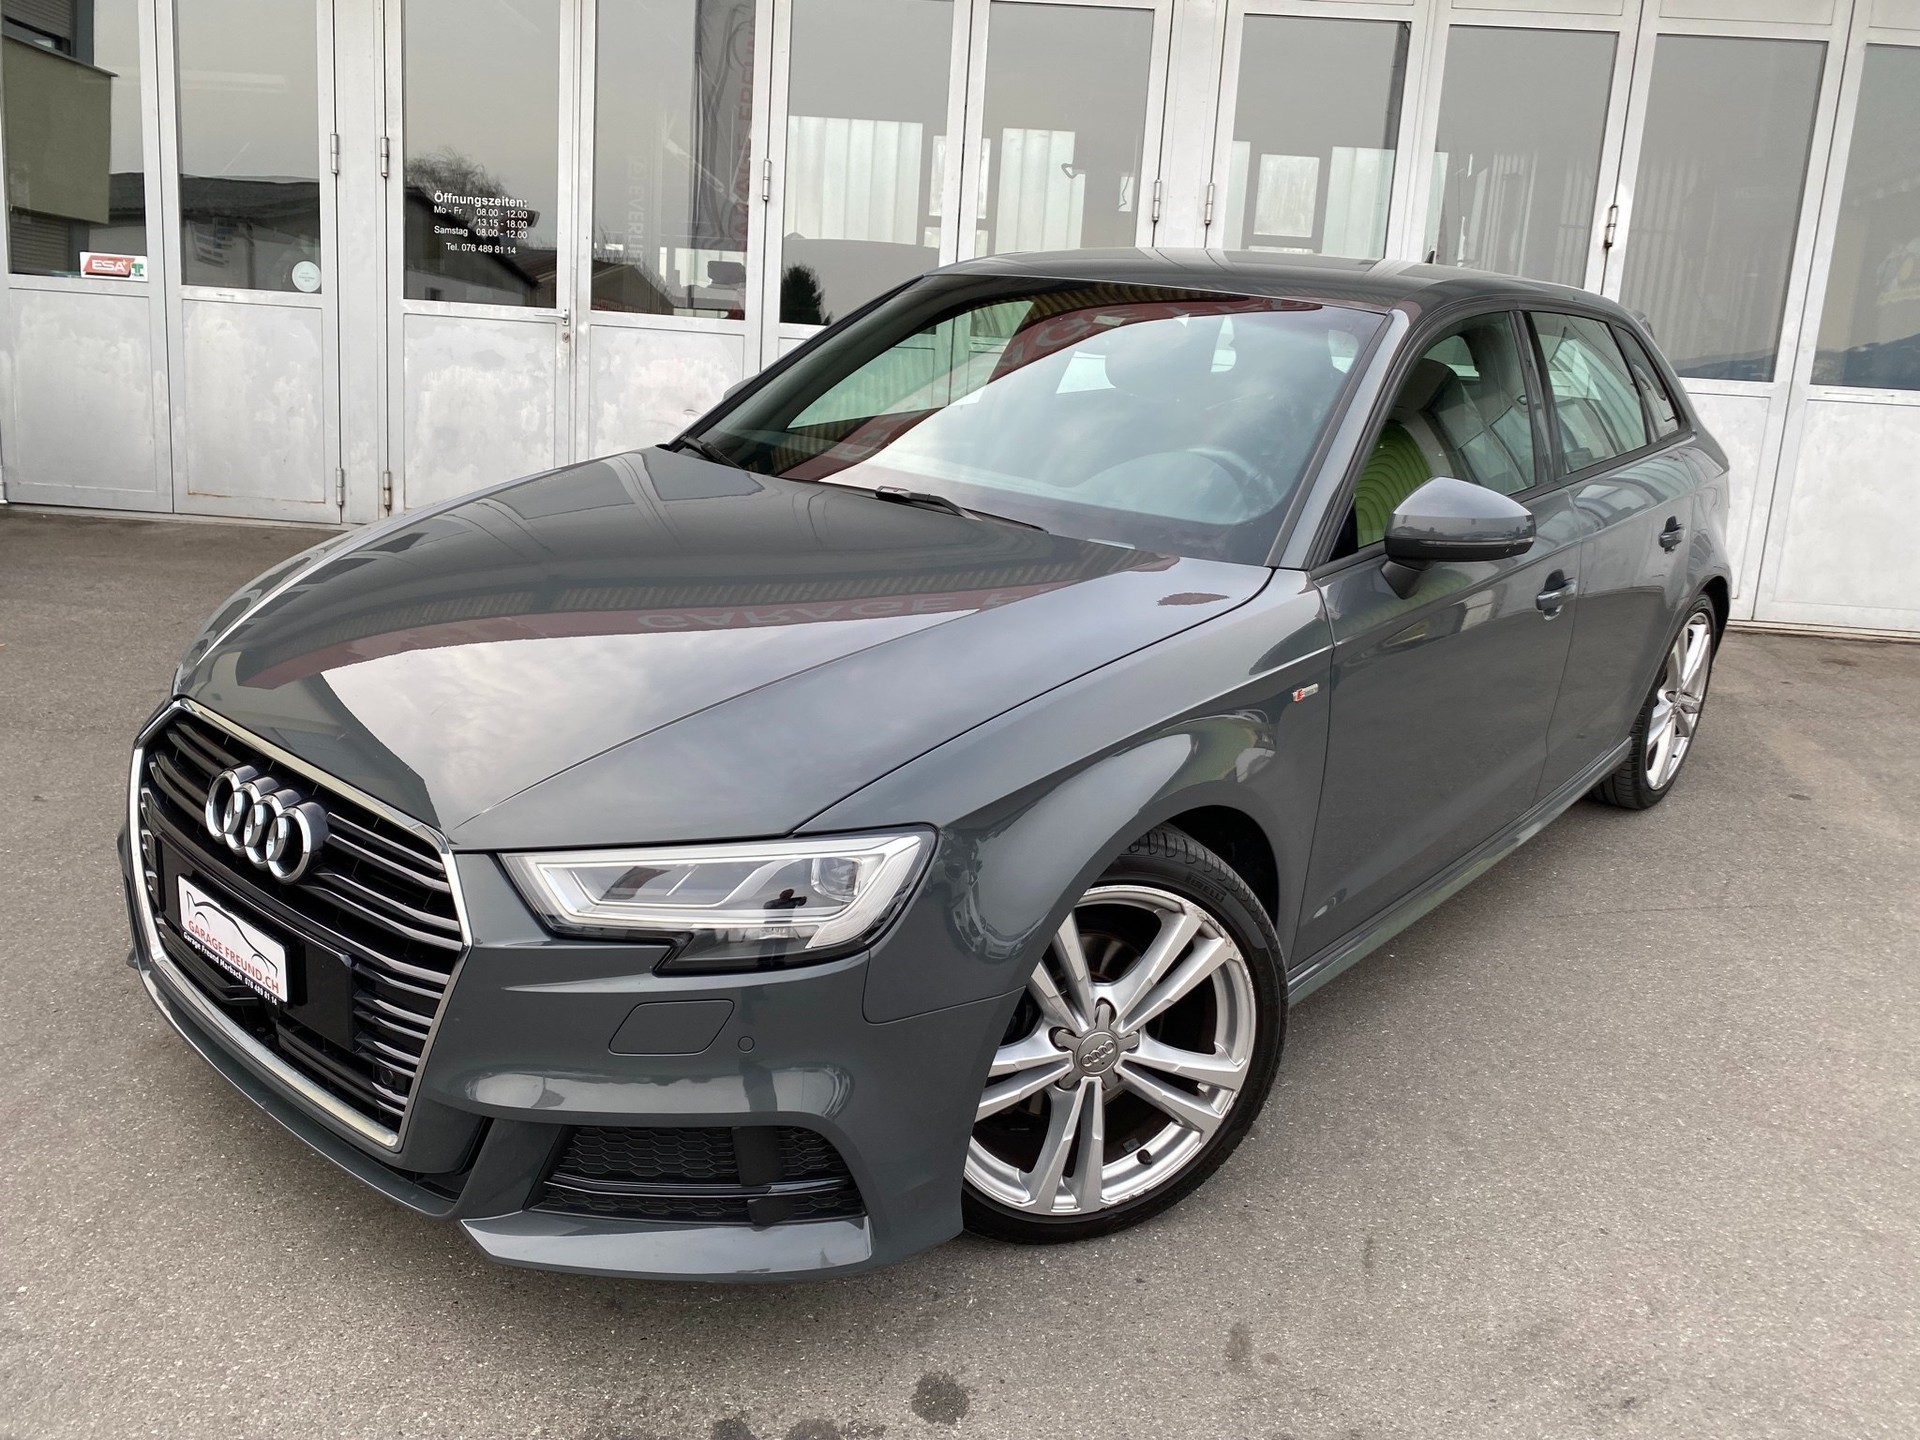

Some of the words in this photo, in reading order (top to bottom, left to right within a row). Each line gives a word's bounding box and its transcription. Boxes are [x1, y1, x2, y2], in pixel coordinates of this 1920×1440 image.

[434, 190, 528, 208] Öffnungszeiten:
[434, 205, 447, 214] Mo
[453, 206, 463, 215] Fr
[476, 208, 499, 217] 08.00
[506, 210, 528, 219] 12.00
[477, 218, 499, 227] 13.15
[506, 220, 528, 229] 18.00
[434, 225, 468, 237] Samstag
[475, 228, 498, 237] 08.00
[506, 230, 528, 239] 12.00
[446, 242, 460, 251] Tel.
[461, 243, 477, 252] 076
[477, 244, 493, 253] 489
[494, 245, 504, 254] 81
[506, 246, 517, 255] 14
[183, 931, 201, 950] Garage
[201, 944, 220, 963] Freund
[219, 959, 243, 981] Marbach
[188, 919, 223, 954] GARAGE
[225, 944, 280, 994] FREUND.CH
